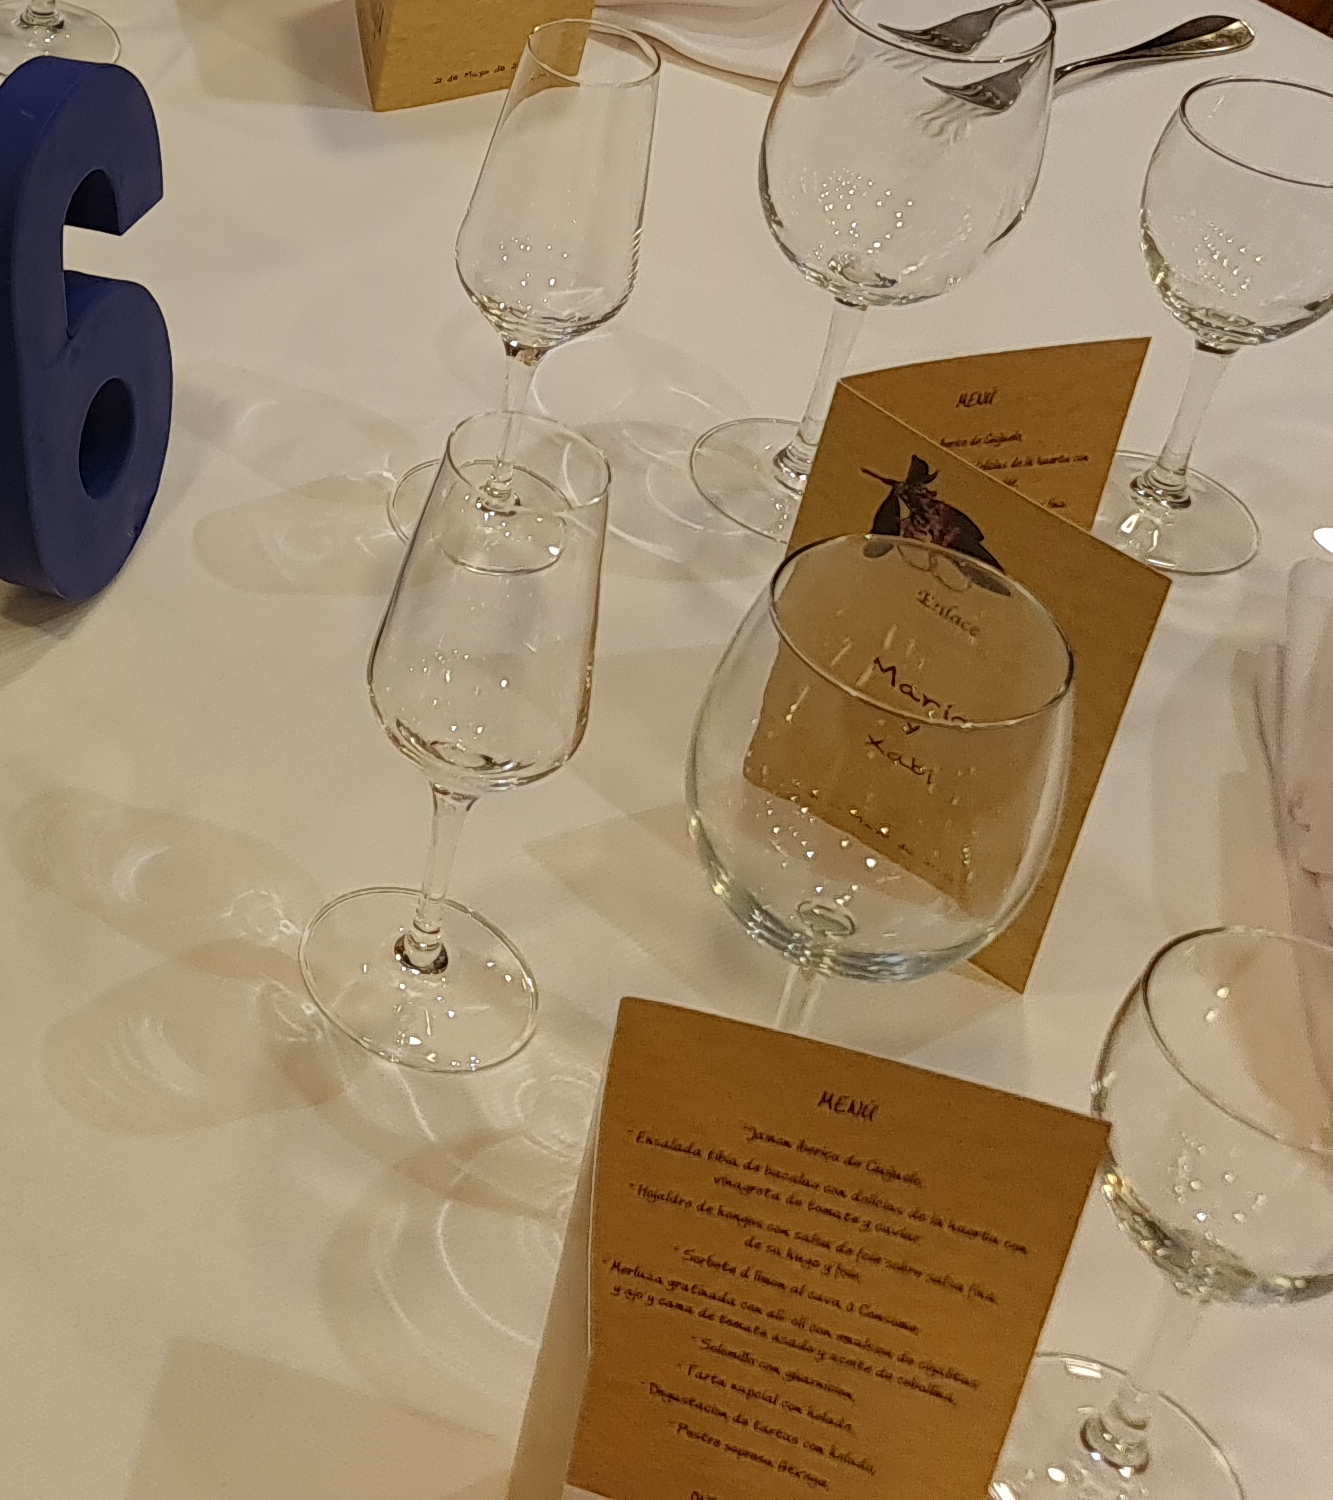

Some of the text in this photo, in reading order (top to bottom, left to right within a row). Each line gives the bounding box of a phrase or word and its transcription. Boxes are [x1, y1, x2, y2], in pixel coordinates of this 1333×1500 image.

[916, 590, 980, 637] Enlace
[636, 1130, 702, 1158] Ensalada
[743, 1158, 761, 1173] de
[907, 1207, 927, 1222] de
[785, 1193, 803, 1207] de
[696, 1200, 714, 1215] de
[835, 1241, 853, 1256] de
[744, 1235, 762, 1250] de
[697, 1306, 715, 1321] de
[687, 1363, 727, 1388] Tarta
[732, 1412, 749, 1427] de
